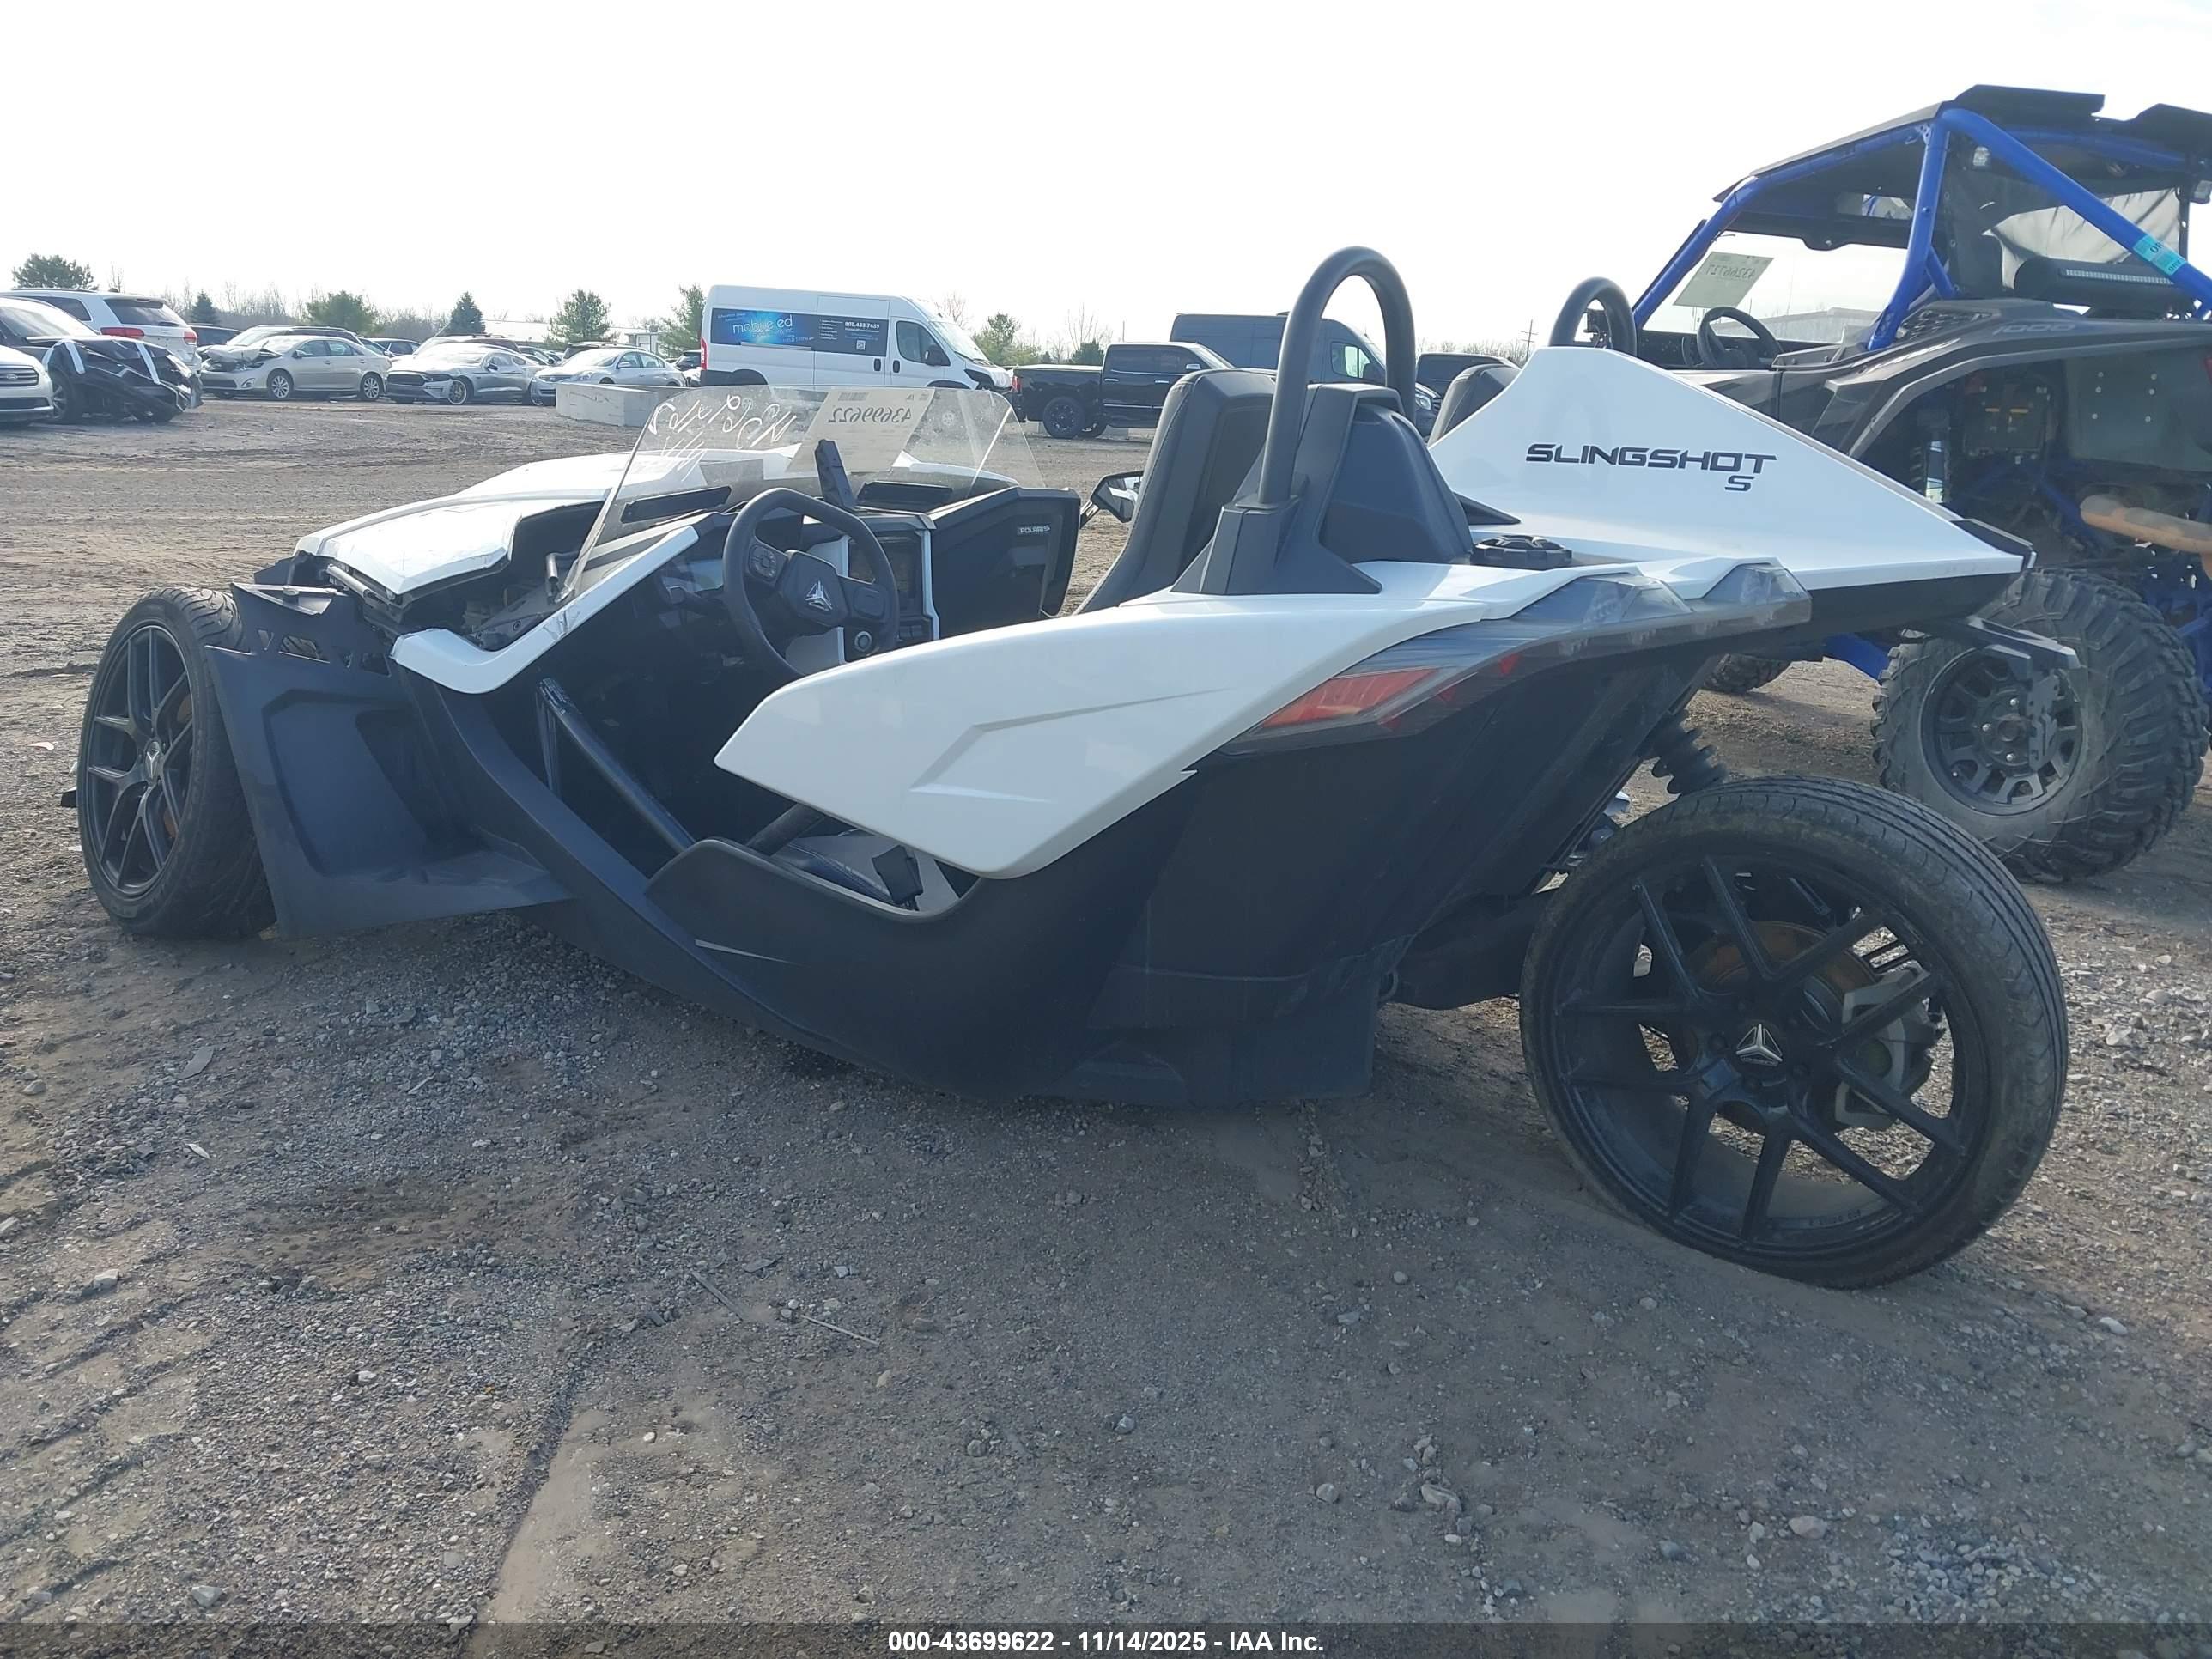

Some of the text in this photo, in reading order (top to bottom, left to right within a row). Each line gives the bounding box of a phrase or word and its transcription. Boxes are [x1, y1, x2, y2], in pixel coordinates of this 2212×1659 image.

[732, 318, 774, 334] mobile
[776, 314, 793, 328] ed
[1525, 443, 1778, 475] SLINGSHOT
[1724, 475, 1755, 492] S
[1020, 524, 1051, 533] POLARIS
